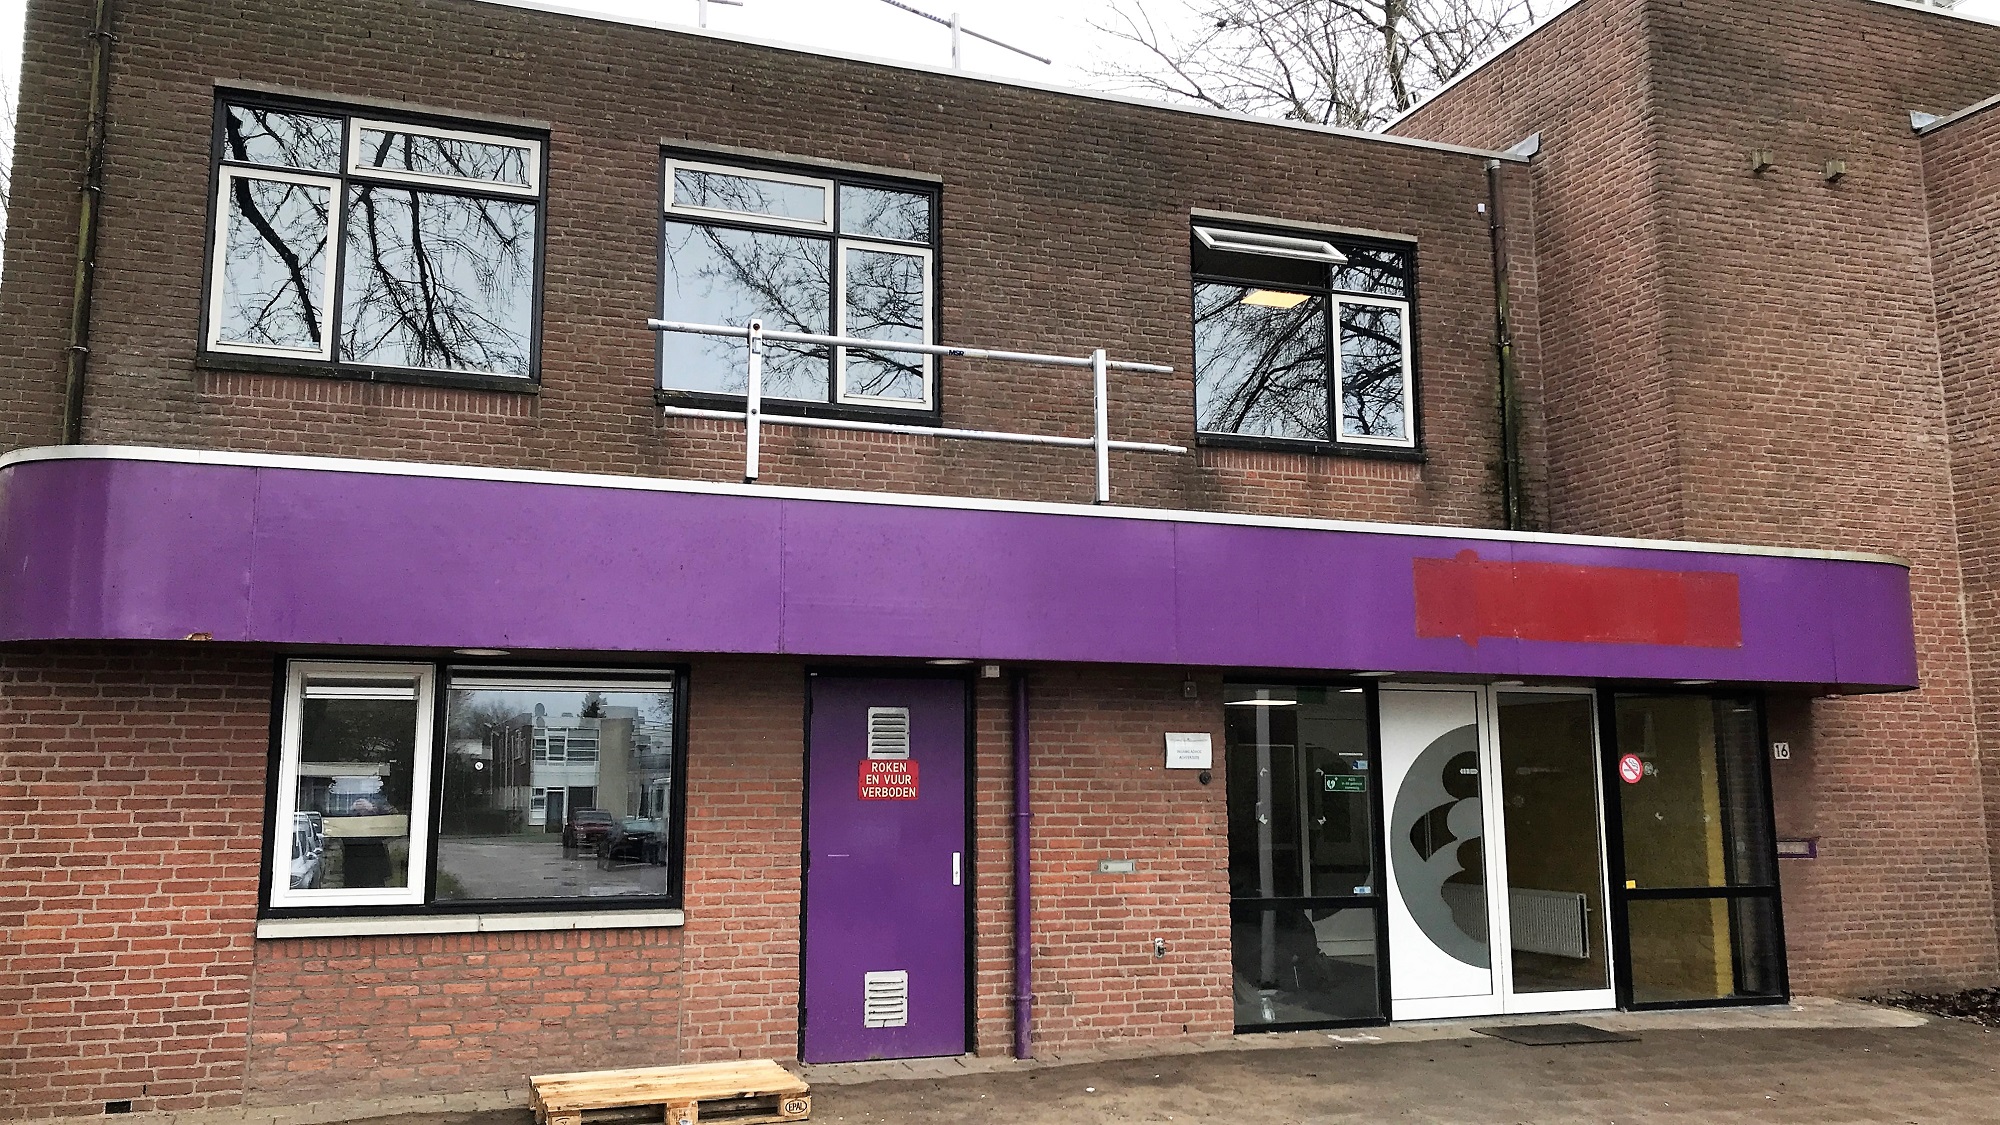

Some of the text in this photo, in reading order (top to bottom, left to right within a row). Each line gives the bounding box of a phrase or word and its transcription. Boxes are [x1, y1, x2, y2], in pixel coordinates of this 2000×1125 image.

[1775, 745, 1788, 757] 16
[872, 762, 907, 773] ROKEN
[866, 774, 912, 785] EN VUUR
[862, 787, 916, 798] VERBODEN
[789, 1102, 804, 1111] EPAL
